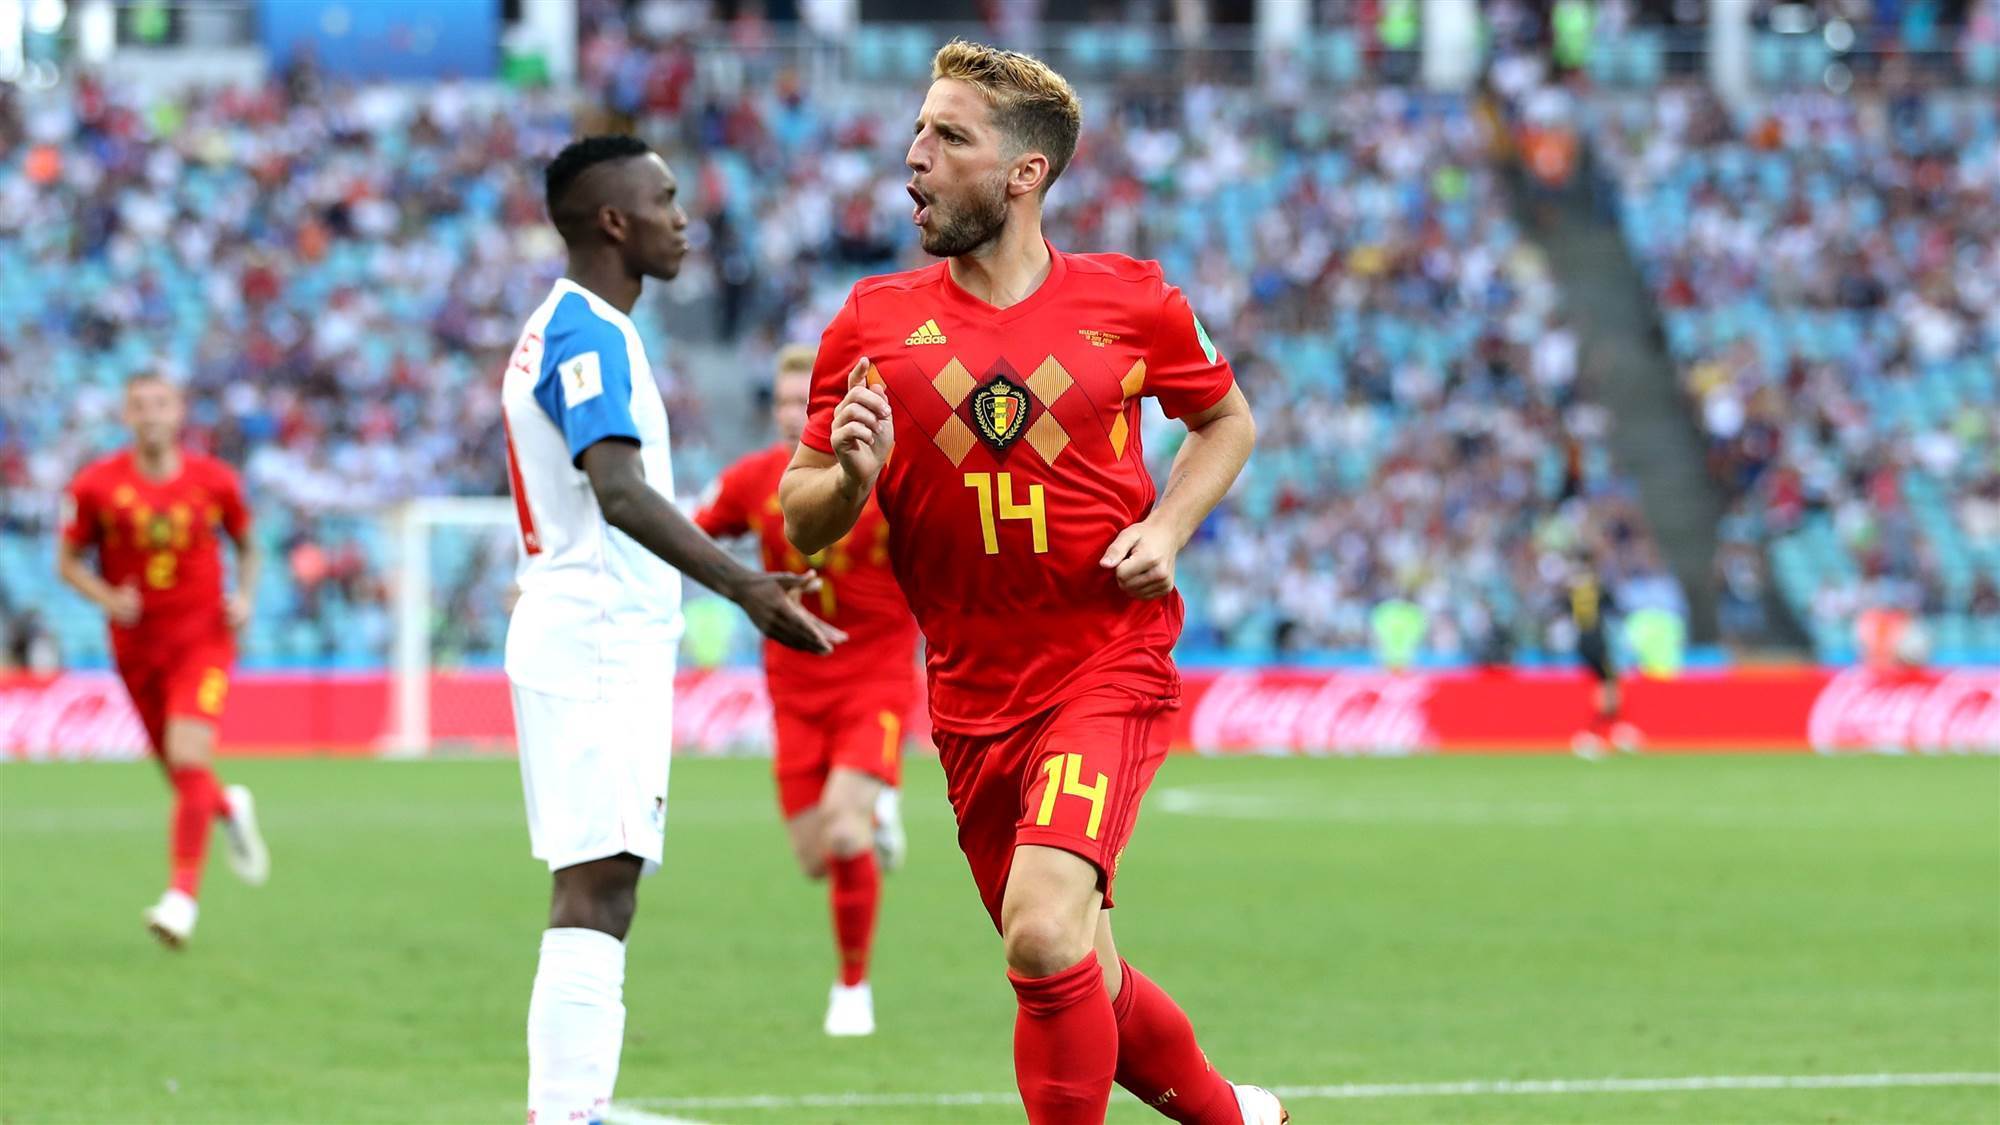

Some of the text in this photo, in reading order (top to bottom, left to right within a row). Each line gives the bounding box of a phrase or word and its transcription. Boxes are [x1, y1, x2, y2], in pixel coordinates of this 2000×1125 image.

[905, 335, 947, 345] adidas
[964, 472, 1048, 555] 14
[1035, 752, 1109, 840] 14
